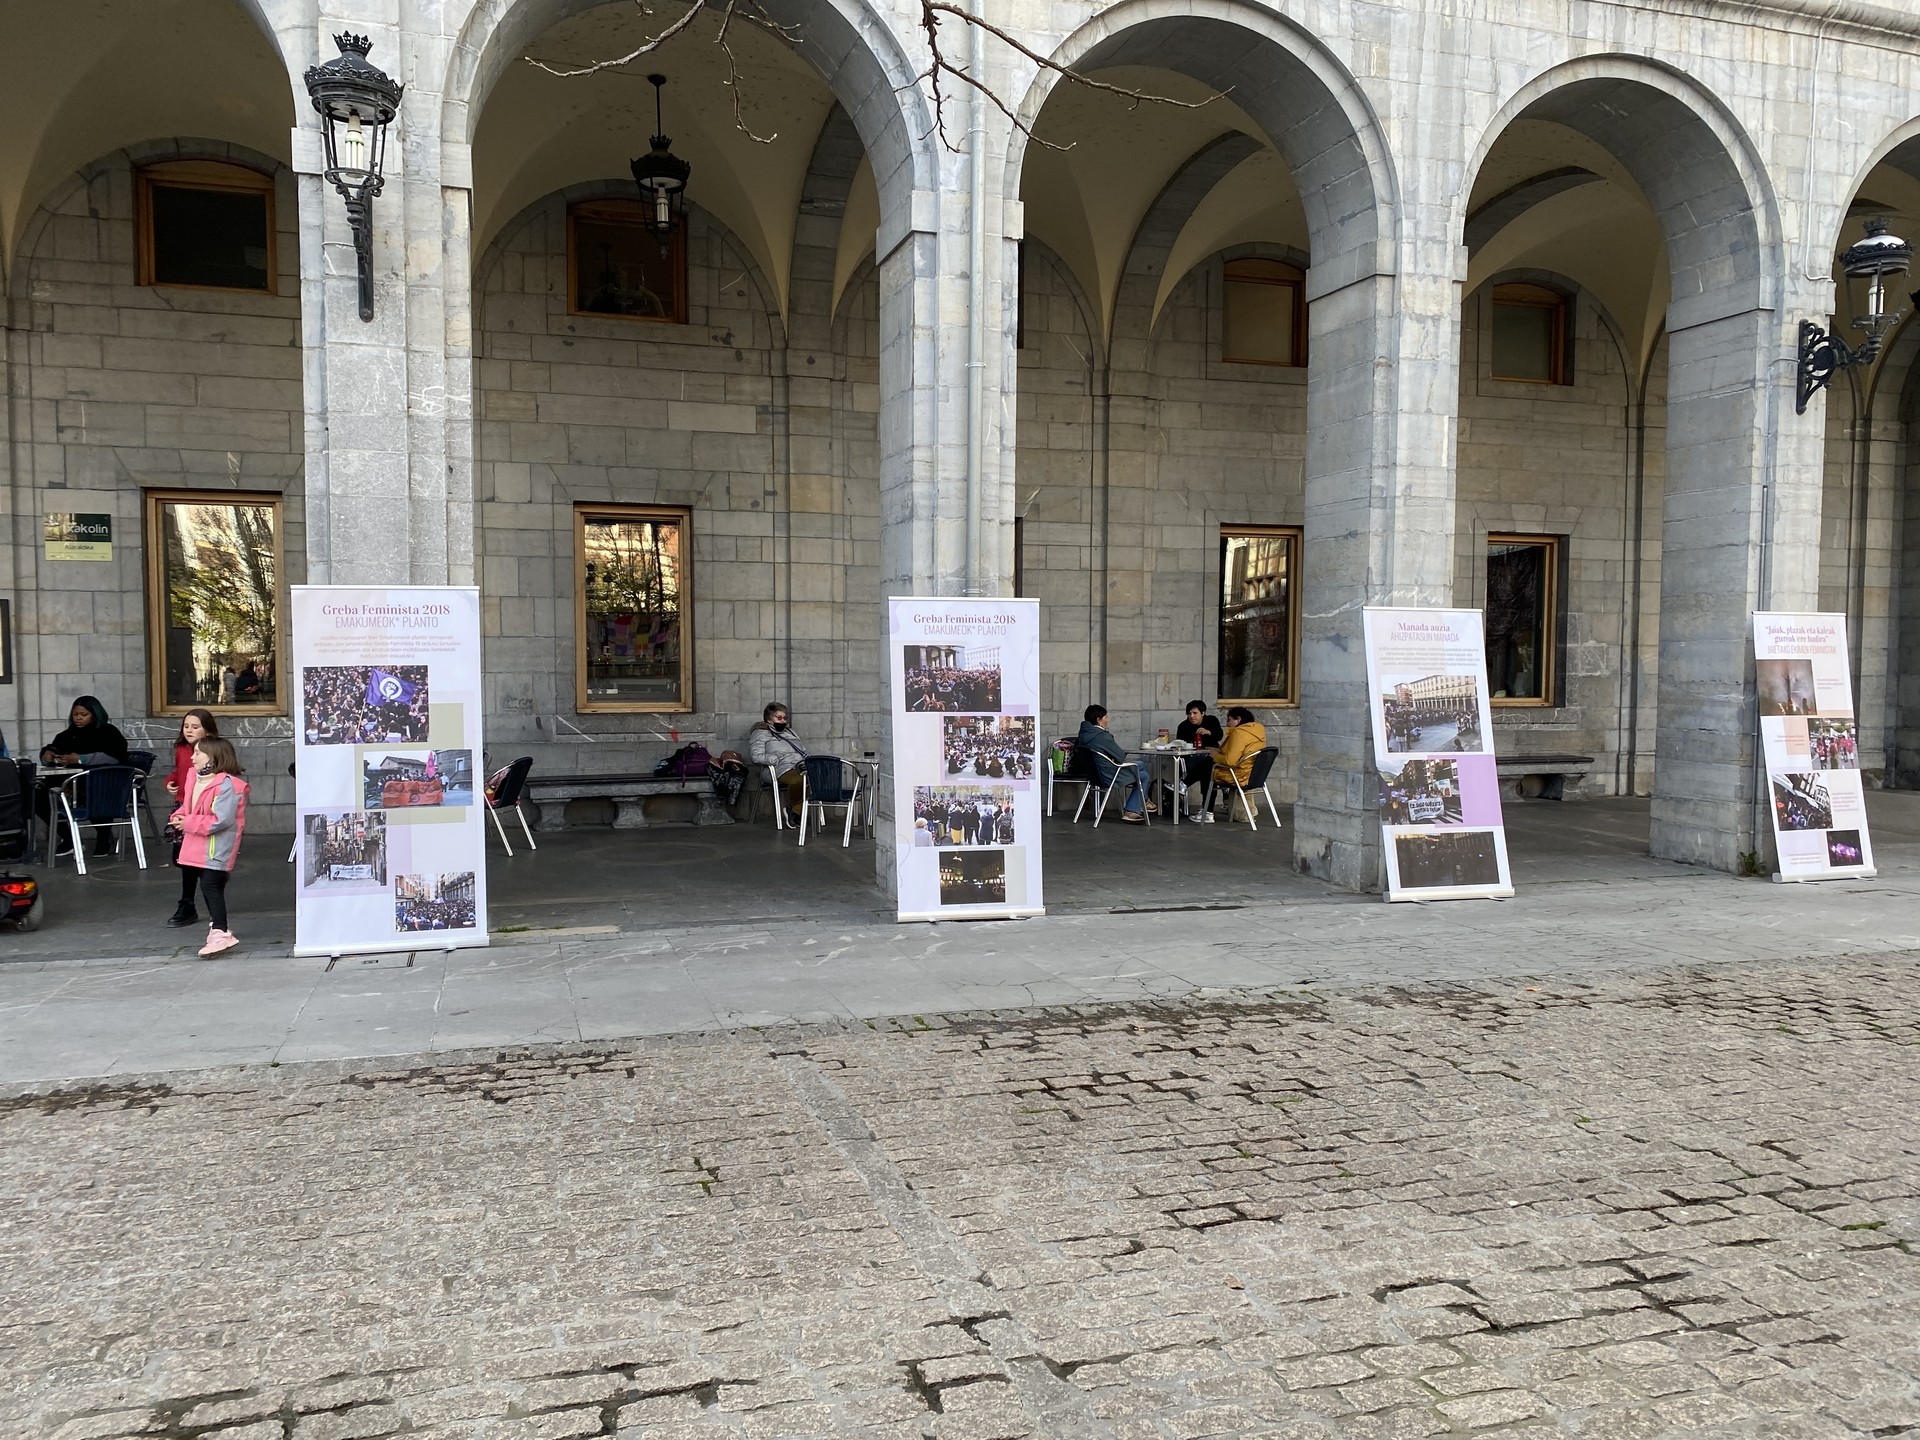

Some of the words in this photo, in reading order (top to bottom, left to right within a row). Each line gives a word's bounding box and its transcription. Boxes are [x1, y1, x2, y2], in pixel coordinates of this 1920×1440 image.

[322, 604, 358, 615] Greba
[362, 604, 419, 615] Feminista
[422, 604, 450, 615] 2018
[402, 616, 439, 628] PLANTO
[913, 614, 942, 624] Greba
[945, 614, 991, 624] Feminista
[993, 614, 1016, 624] 2018
[978, 625, 1007, 636] PLANTO
[1398, 622, 1428, 632] Manada
[1430, 624, 1450, 632] auzia
[1786, 626, 1806, 635] plazak
[1817, 626, 1835, 634] kaleak
[1390, 632, 1432, 641] AHIZPATASUN
[1434, 632, 1460, 642] MANADA
[1774, 635, 1796, 644] gureak
